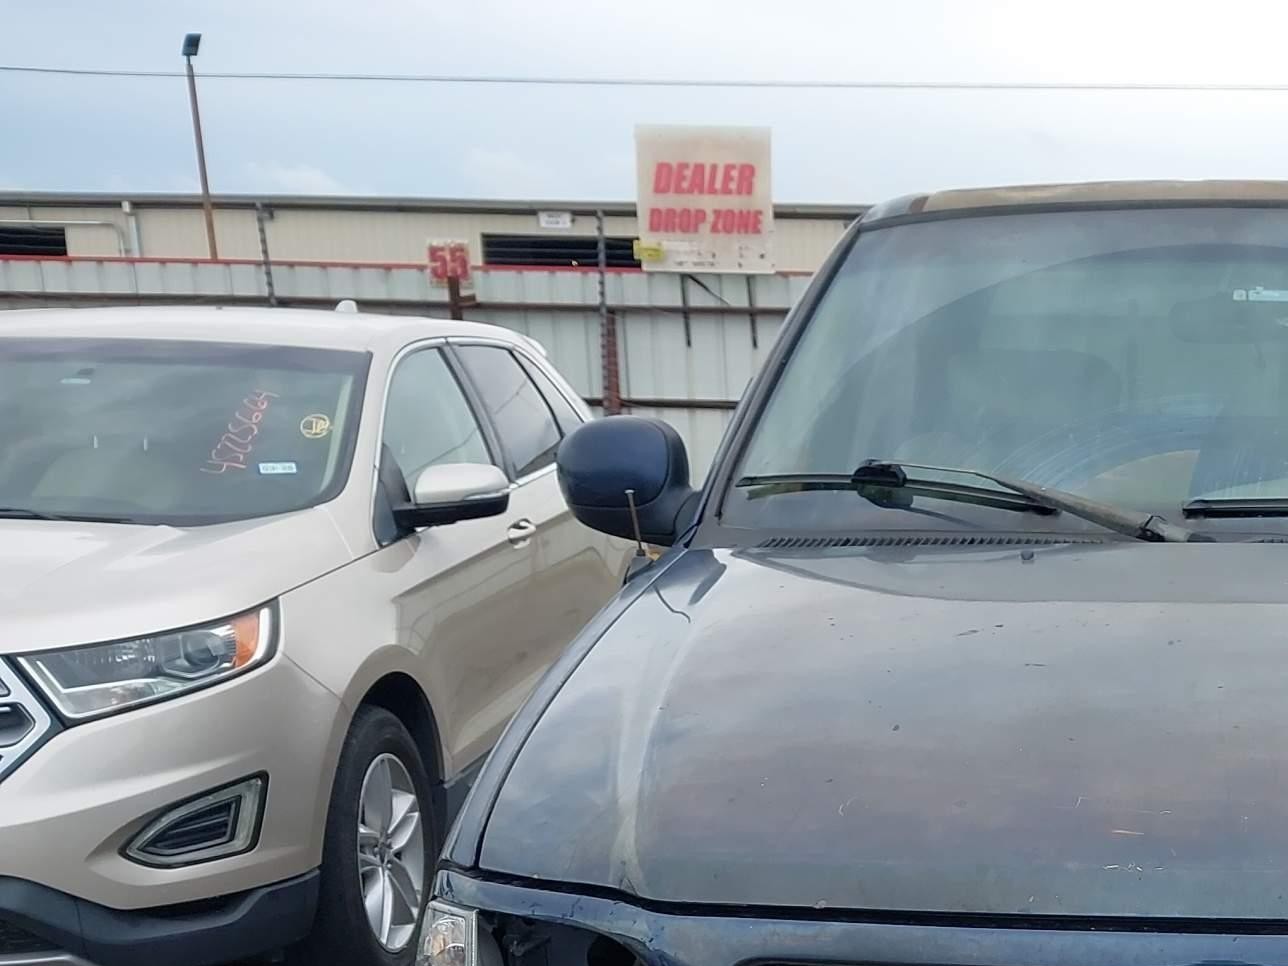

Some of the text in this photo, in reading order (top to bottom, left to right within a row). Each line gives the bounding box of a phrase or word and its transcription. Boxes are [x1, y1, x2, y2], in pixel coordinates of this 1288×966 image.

[653, 162, 756, 195] DEALER
[648, 207, 763, 235] DROP ZONE
[429, 244, 469, 280] 55
